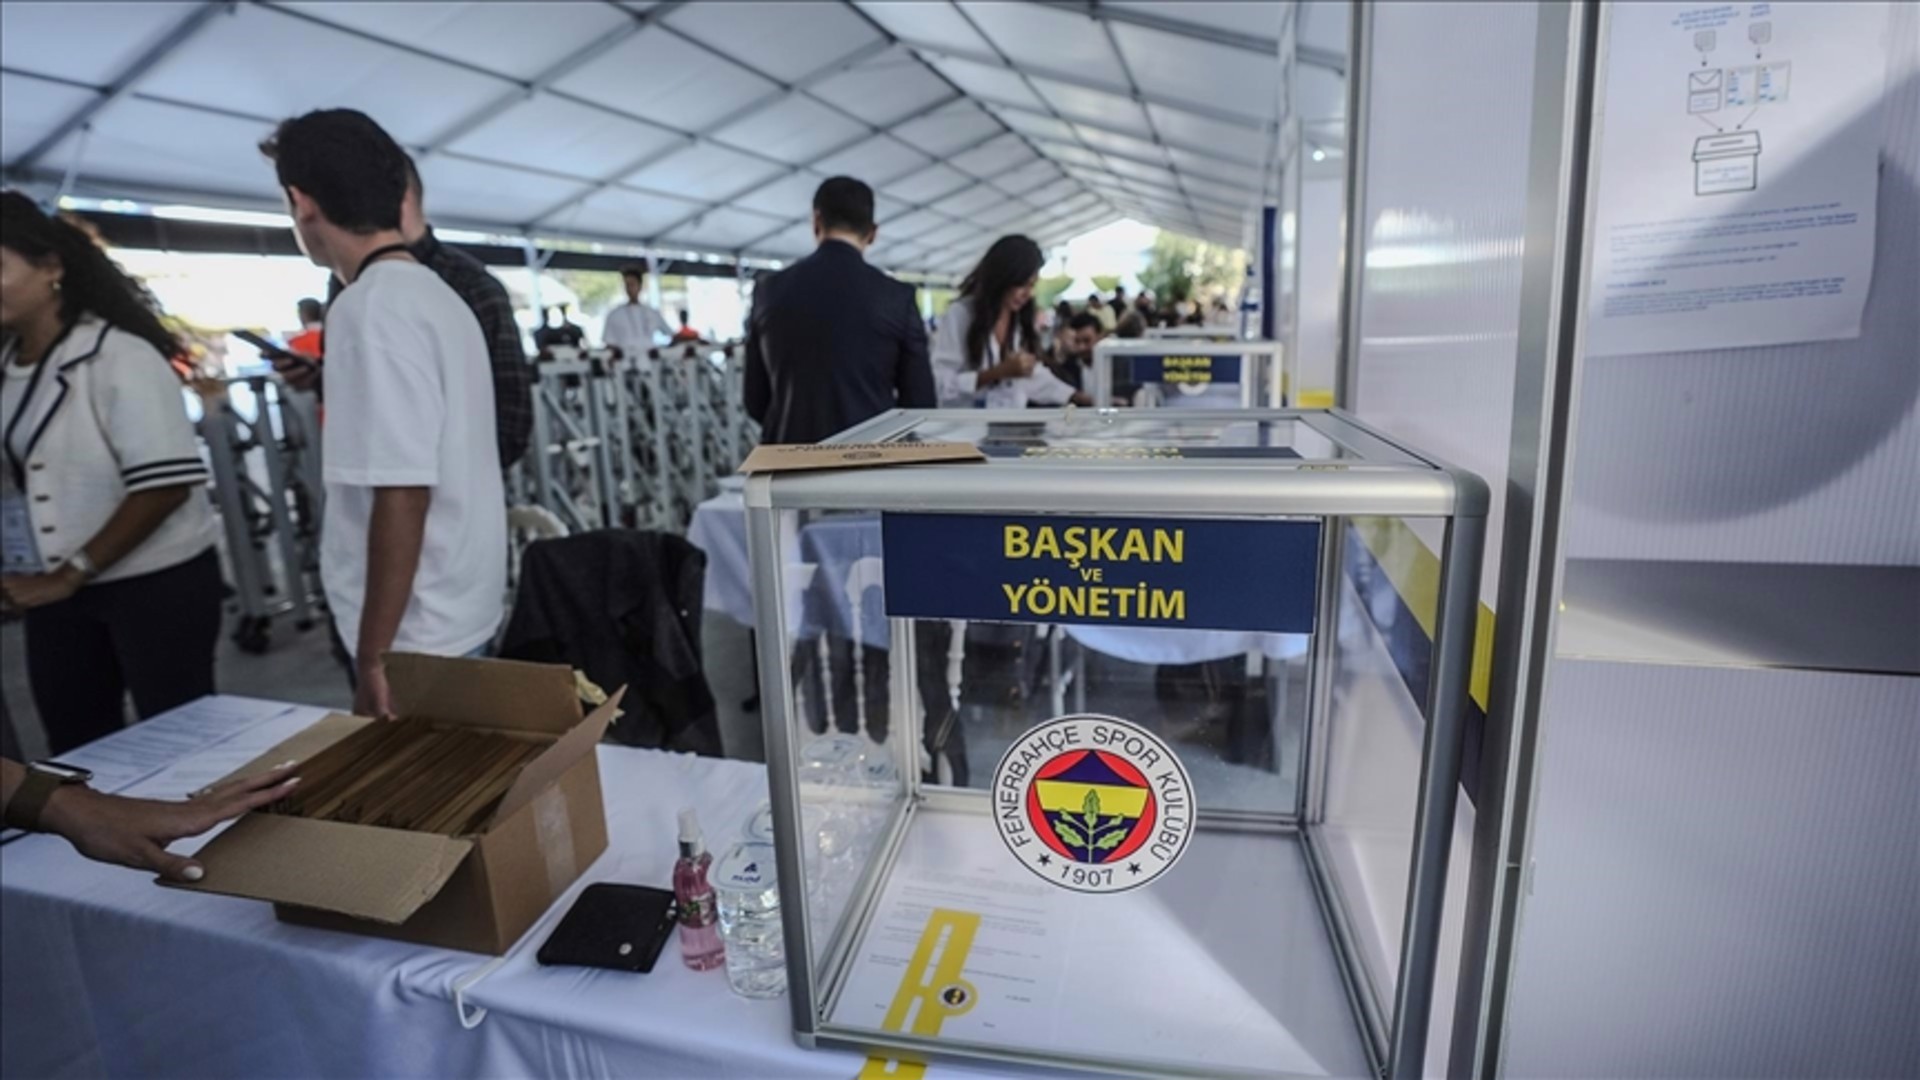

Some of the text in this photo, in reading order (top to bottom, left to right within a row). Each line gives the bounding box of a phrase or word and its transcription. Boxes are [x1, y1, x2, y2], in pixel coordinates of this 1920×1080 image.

[1003, 525, 1184, 568] BAŞKAN
[1080, 568, 1103, 582] VE
[1002, 577, 1186, 619] YÖNETİM
[1000, 725, 1187, 861] FENERBAHÇE SPOR KULÜBÜ
[1061, 865, 1114, 886] 1907
